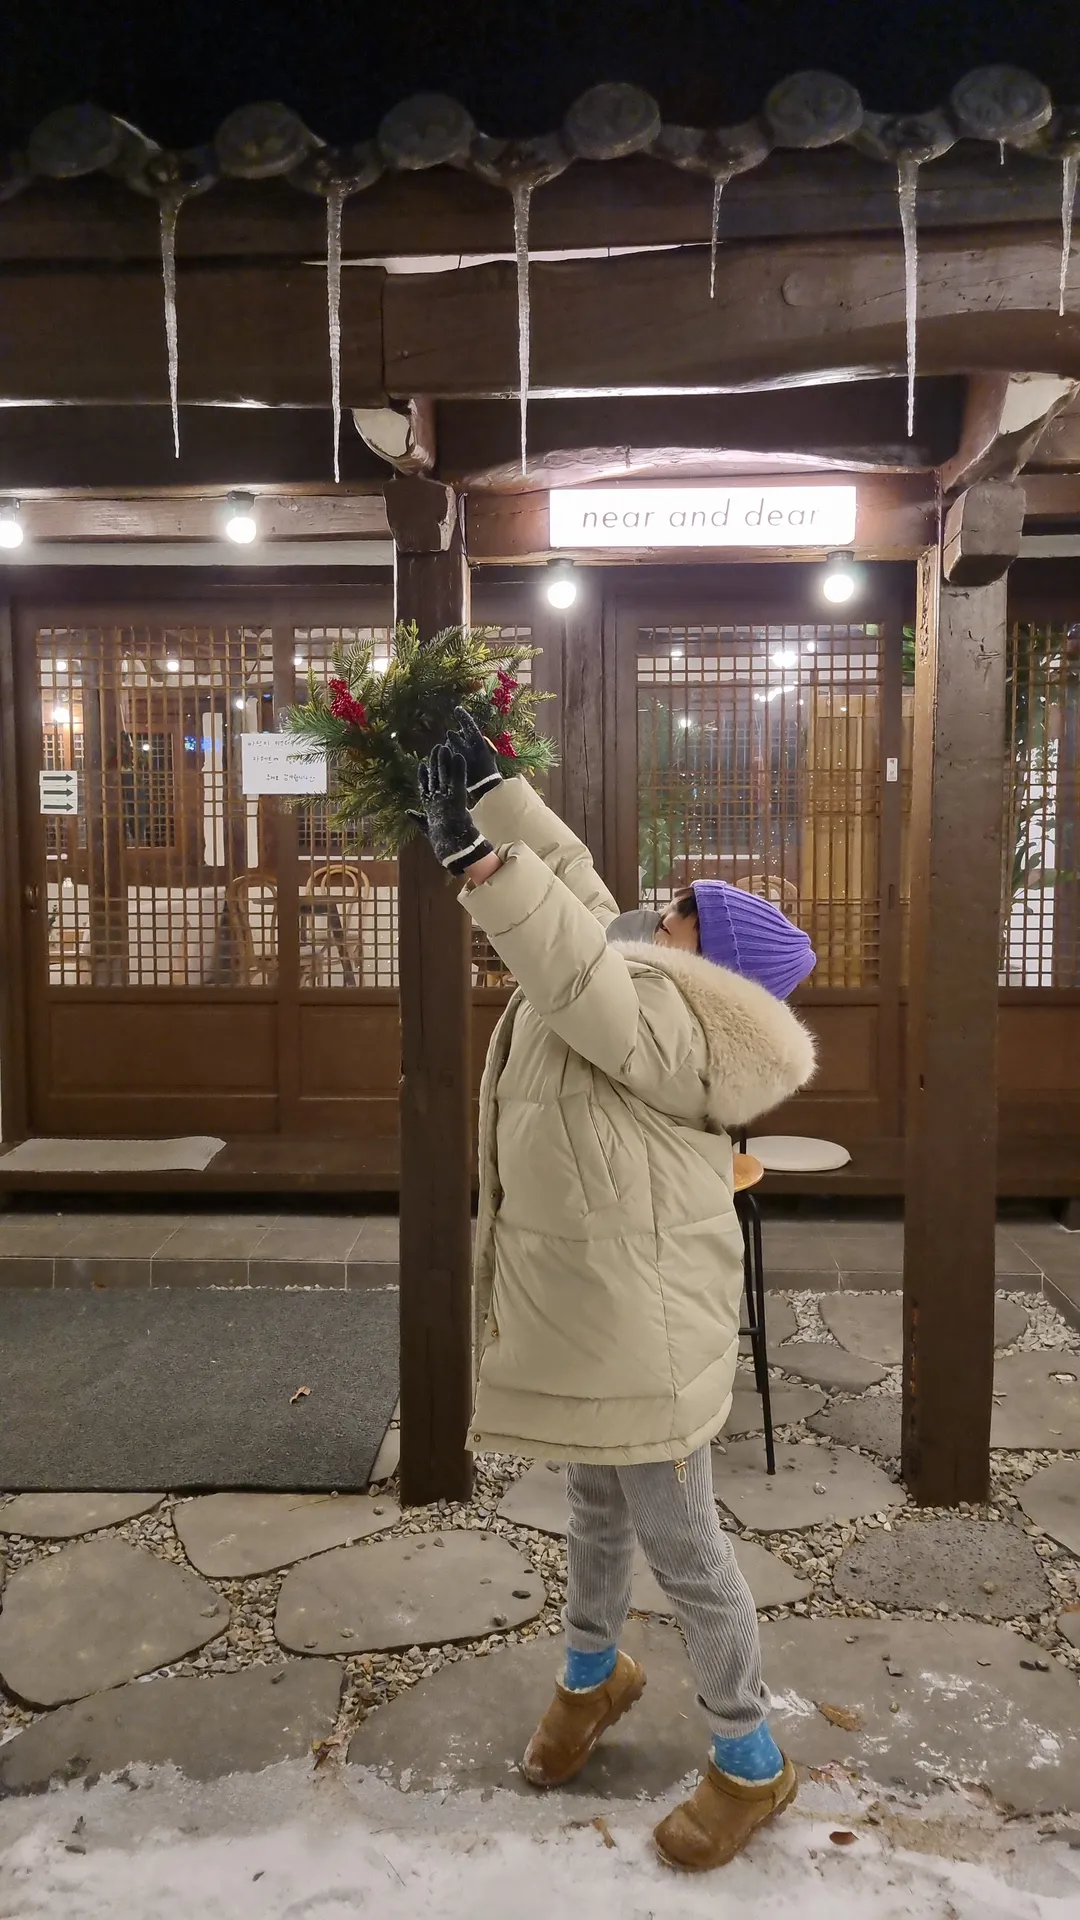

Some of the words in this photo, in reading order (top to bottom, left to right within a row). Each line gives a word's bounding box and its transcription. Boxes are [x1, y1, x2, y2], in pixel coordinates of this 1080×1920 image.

[582, 510, 655, 528] near
[669, 498, 730, 528] and
[744, 497, 820, 527] dear
